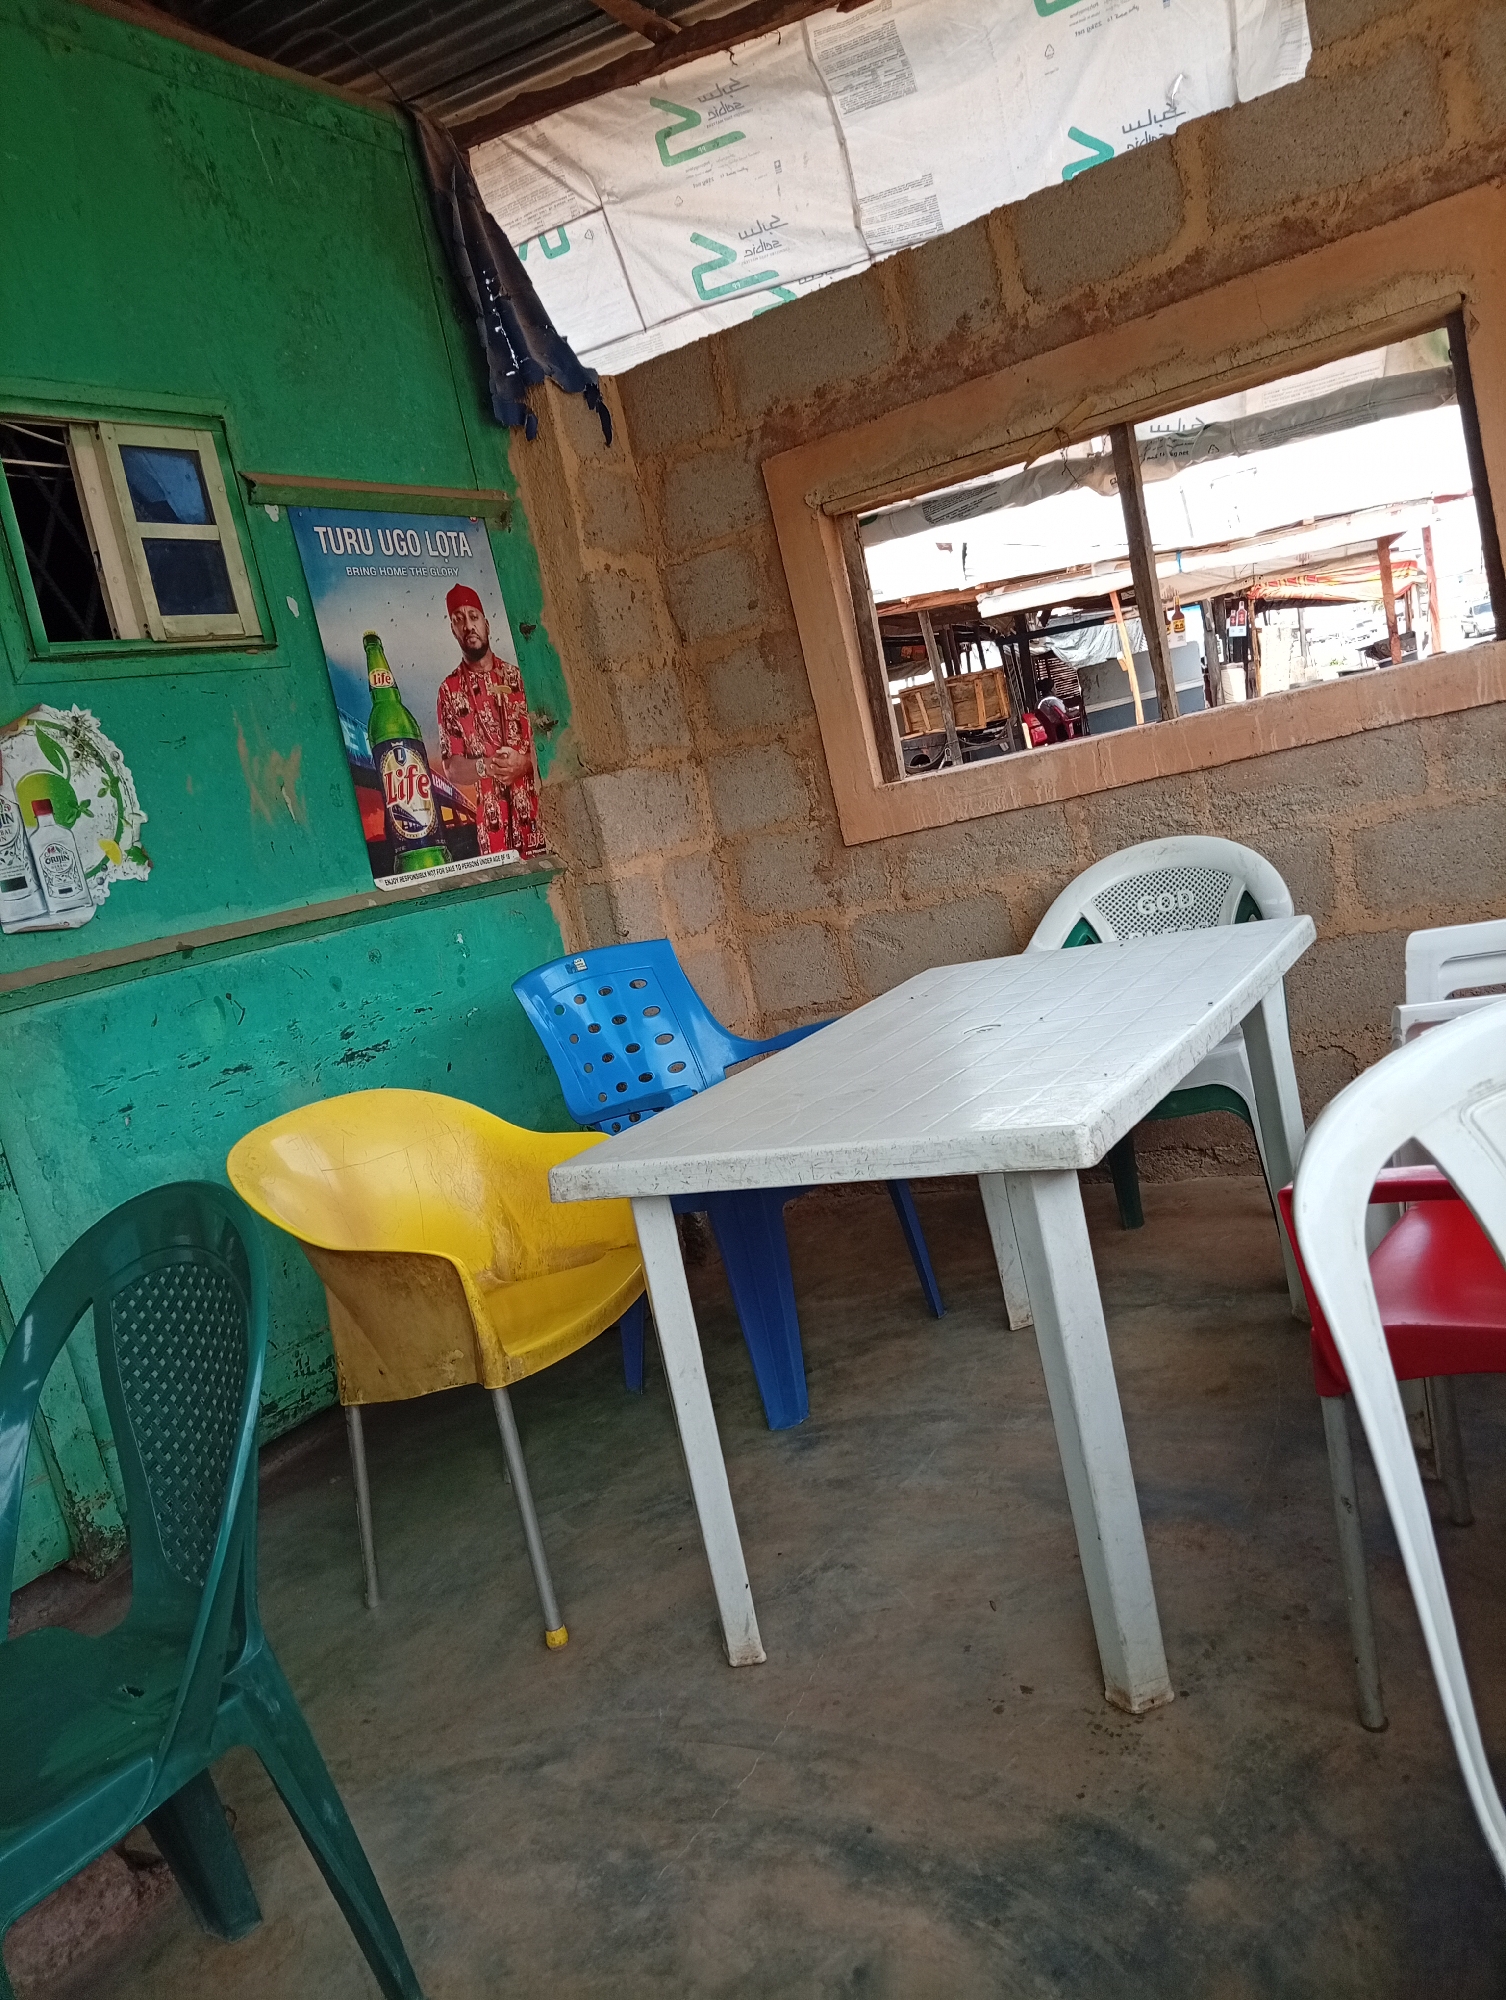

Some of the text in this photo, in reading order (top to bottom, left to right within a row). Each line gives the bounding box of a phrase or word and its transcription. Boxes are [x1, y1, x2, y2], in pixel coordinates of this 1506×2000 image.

[313, 526, 374, 556] TURU
[377, 528, 422, 557] UGO
[346, 566, 459, 577] BRING HOME THE GLORY
[384, 764, 432, 808] Life
[384, 876, 399, 886] ENJOY
[399, 871, 428, 884] RESPONSIBLY
[436, 867, 446, 875] FOR
[446, 865, 456, 874] SALE
[456, 863, 462, 871] TO
[461, 860, 480, 870] PERSONS
[479, 857, 493, 866] UNDER
[1137, 889, 1194, 915] GOD
